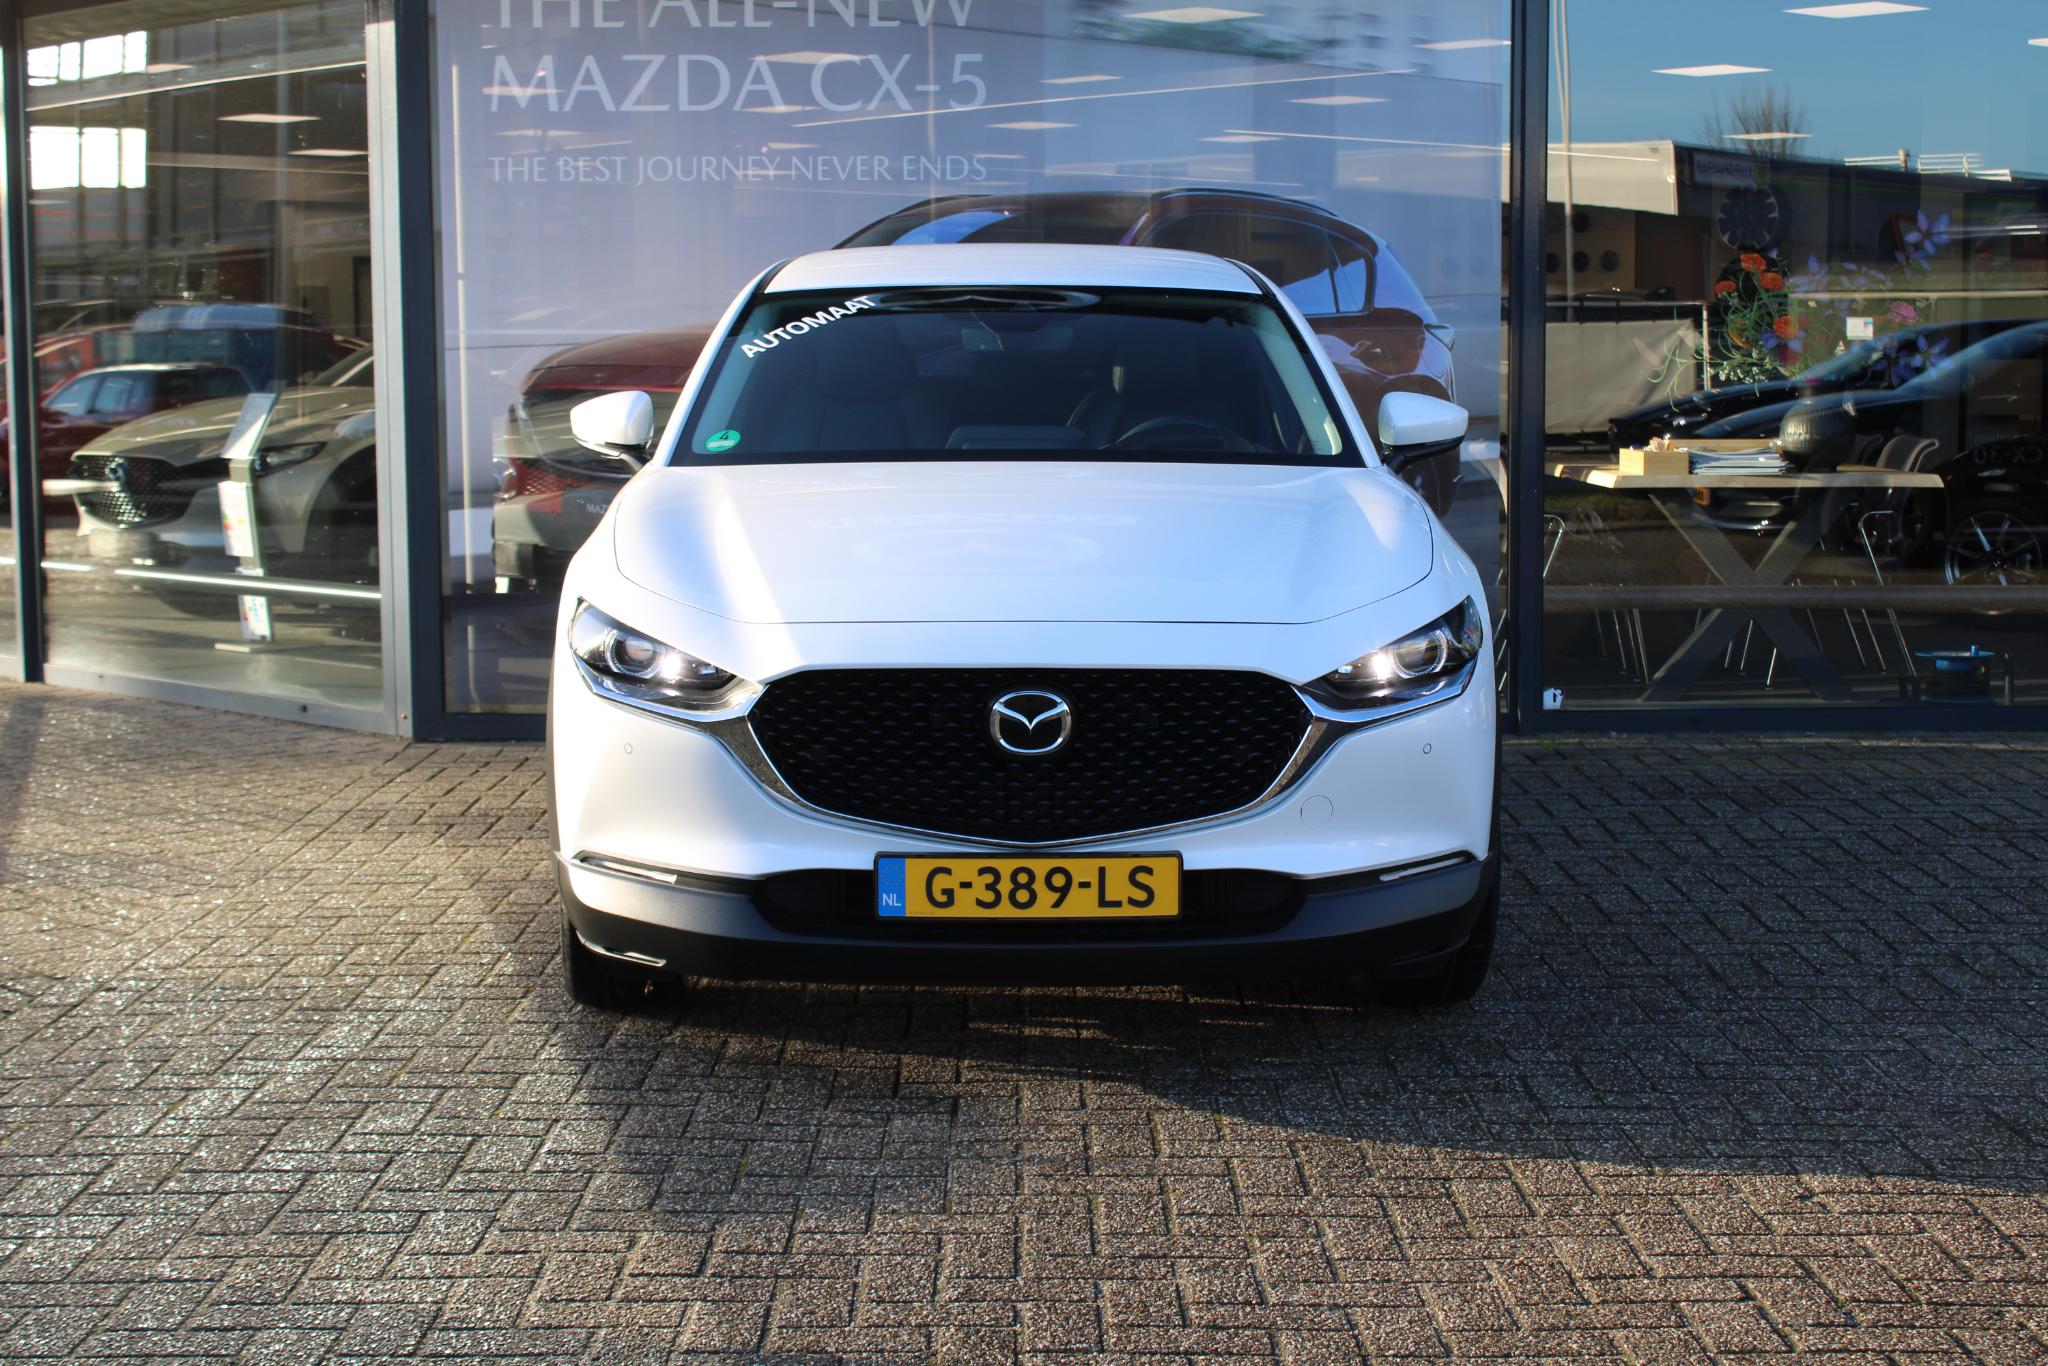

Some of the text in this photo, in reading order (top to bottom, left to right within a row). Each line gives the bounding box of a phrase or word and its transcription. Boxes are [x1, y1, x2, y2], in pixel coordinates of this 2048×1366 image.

[490, 53, 987, 112] MAZDA CX-5
[487, 154, 987, 187] THE BEST JOURNEY NEVER ENDS
[741, 295, 877, 358] AUTOMAAT
[719, 431, 729, 441] 4
[882, 865, 1156, 910] NL G-389-LS
